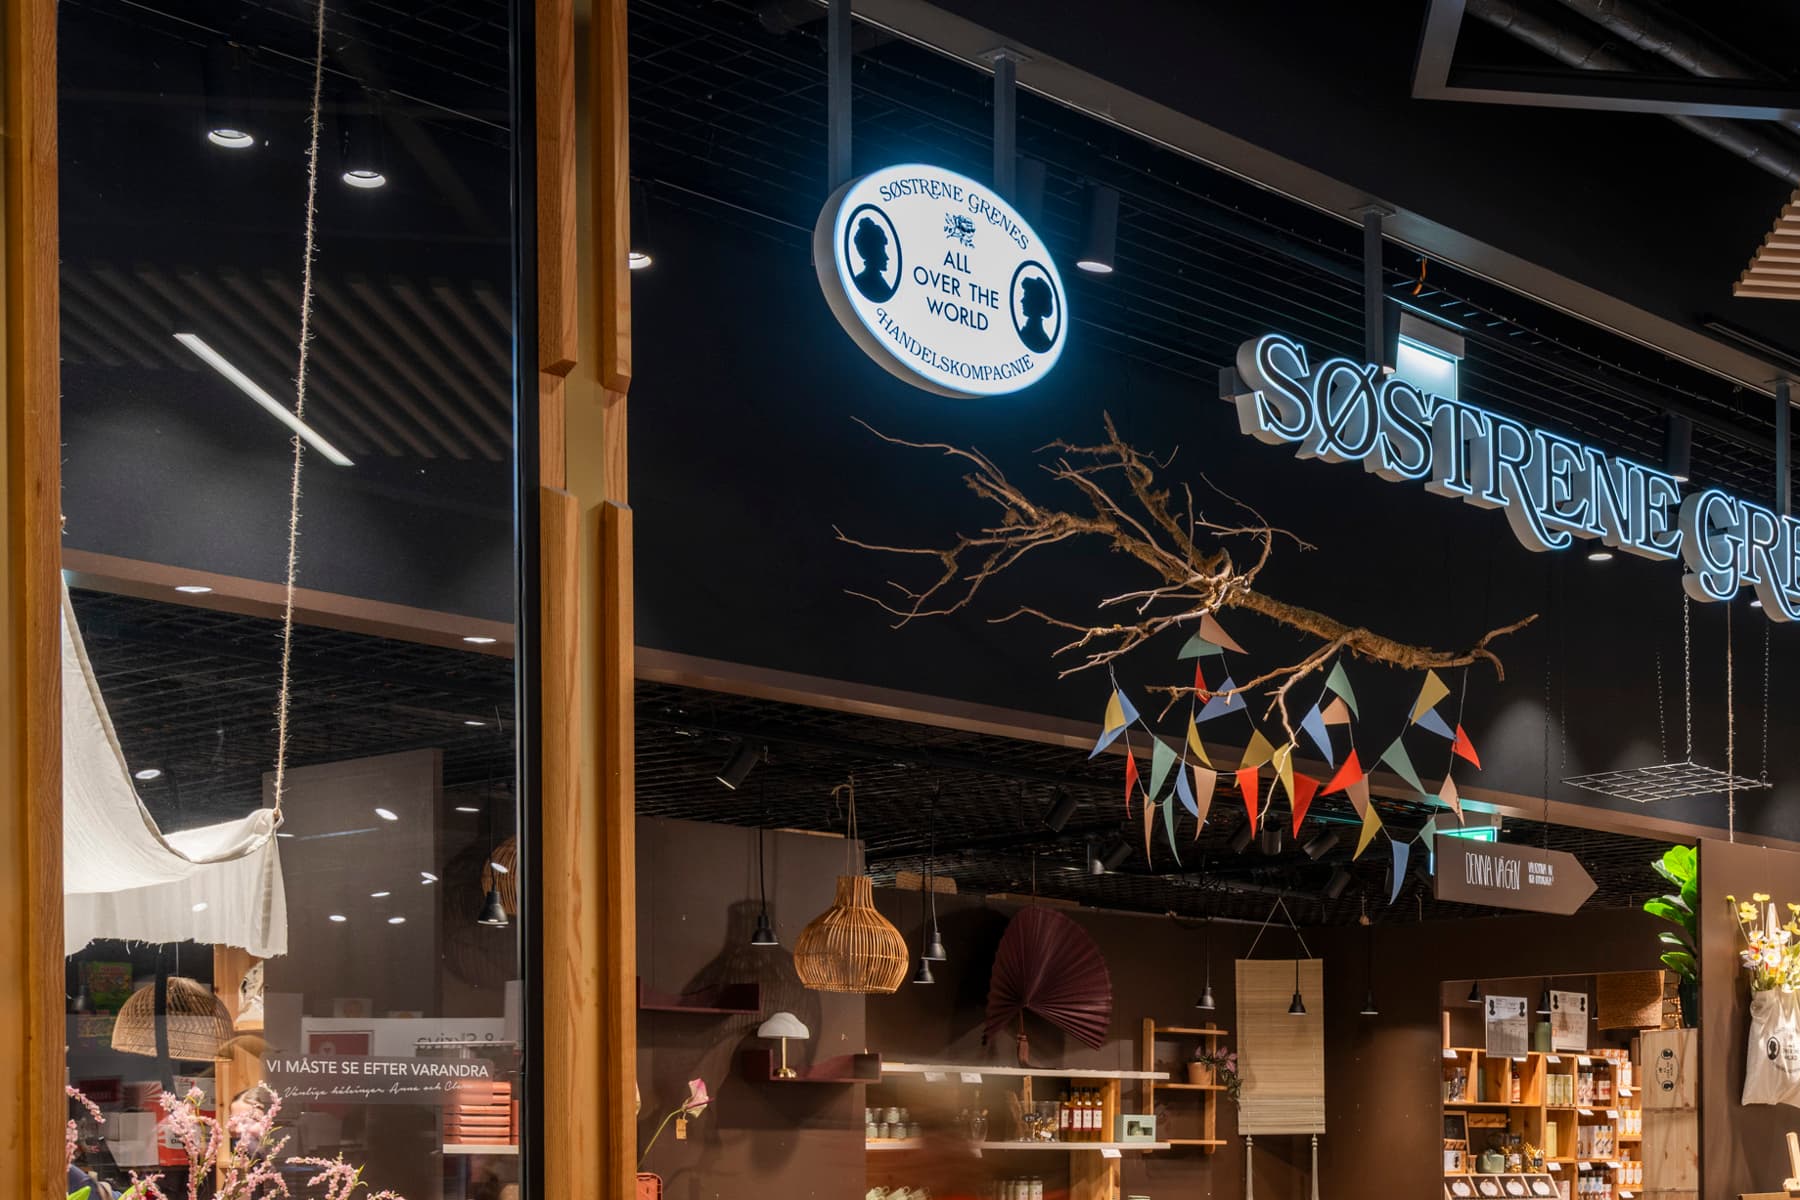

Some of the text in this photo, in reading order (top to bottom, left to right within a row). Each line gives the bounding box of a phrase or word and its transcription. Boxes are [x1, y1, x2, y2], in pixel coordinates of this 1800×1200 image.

[878, 177, 1030, 251] SØSTRENE GRENES
[943, 250, 972, 274] ALL
[913, 265, 1000, 310] OVER THE
[926, 296, 989, 331] WORLD
[876, 307, 1035, 381] HANDELSKOMPAGNIE
[1253, 333, 1685, 559] SØSTRENE
[266, 1057, 489, 1077] VI MÅSTE SE EFTER VARANDRA
